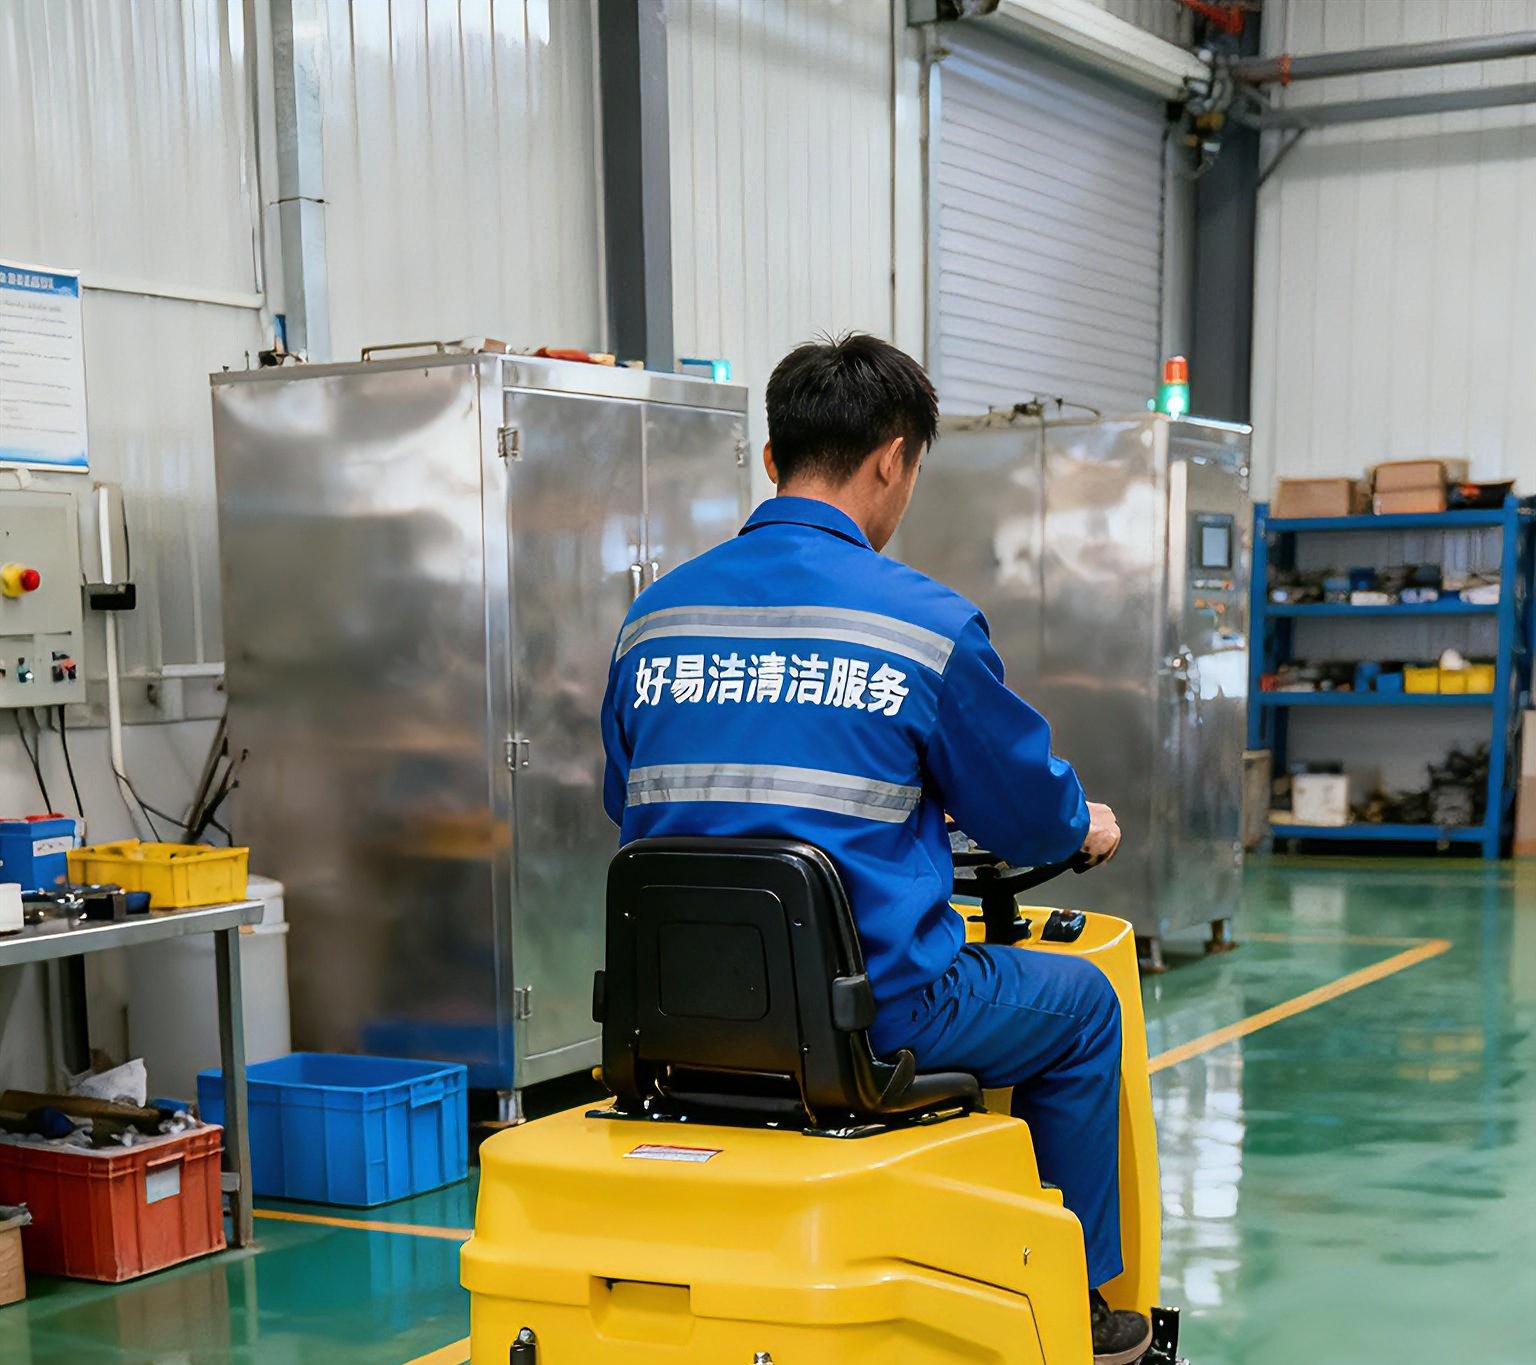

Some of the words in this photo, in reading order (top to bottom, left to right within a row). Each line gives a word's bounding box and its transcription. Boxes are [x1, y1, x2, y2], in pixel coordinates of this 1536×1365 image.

[633, 651, 910, 717] 好易洁清洁服务
